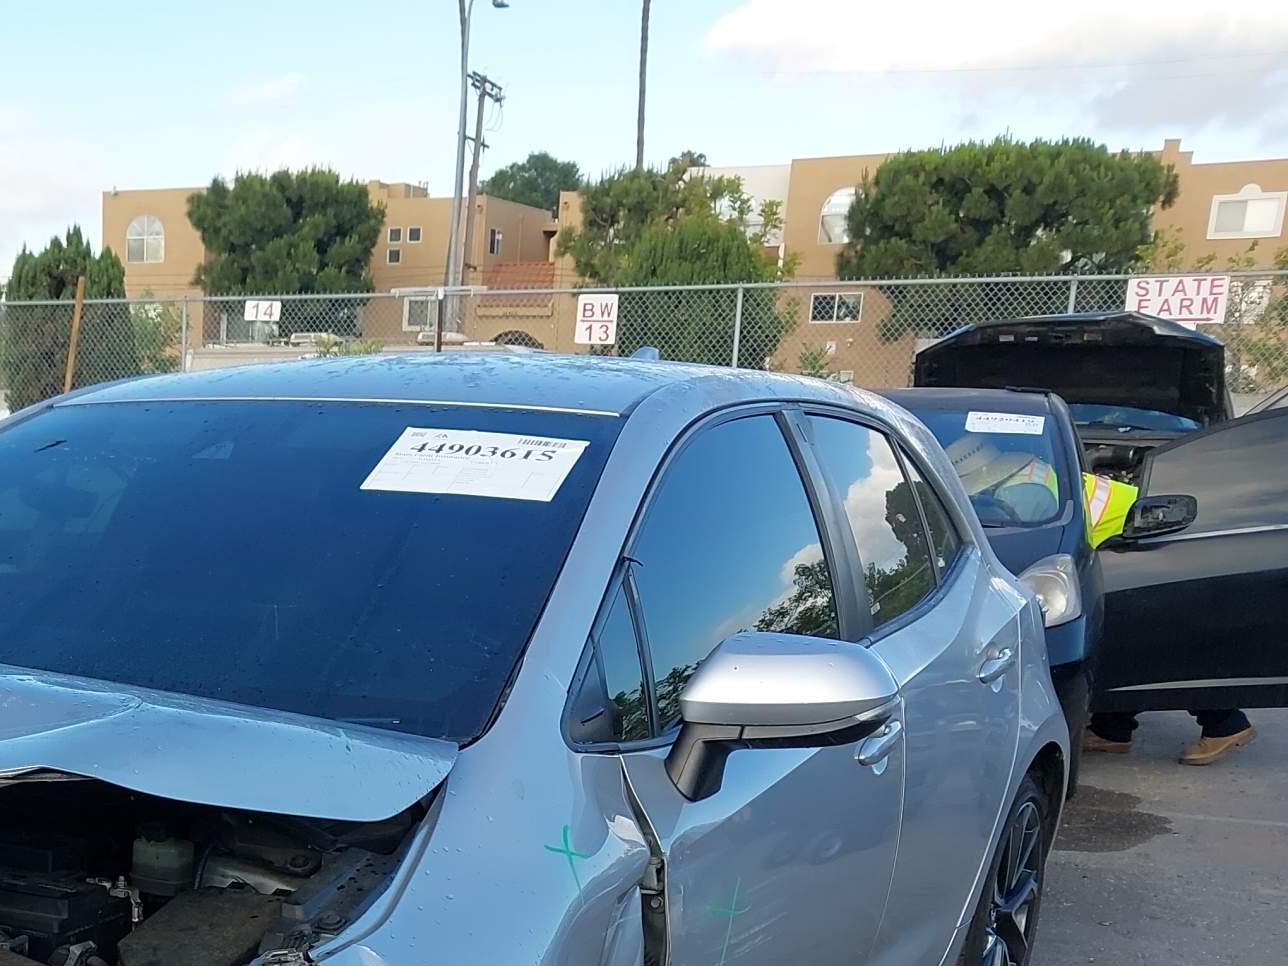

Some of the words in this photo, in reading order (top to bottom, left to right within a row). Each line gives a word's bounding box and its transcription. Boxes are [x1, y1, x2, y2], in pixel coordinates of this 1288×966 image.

[1135, 277, 1226, 297] STATE
[250, 302, 274, 320] 14
[582, 301, 614, 319] BW
[1136, 296, 1219, 316] FARM
[584, 324, 611, 342] 13
[410, 440, 558, 463] 44903615
